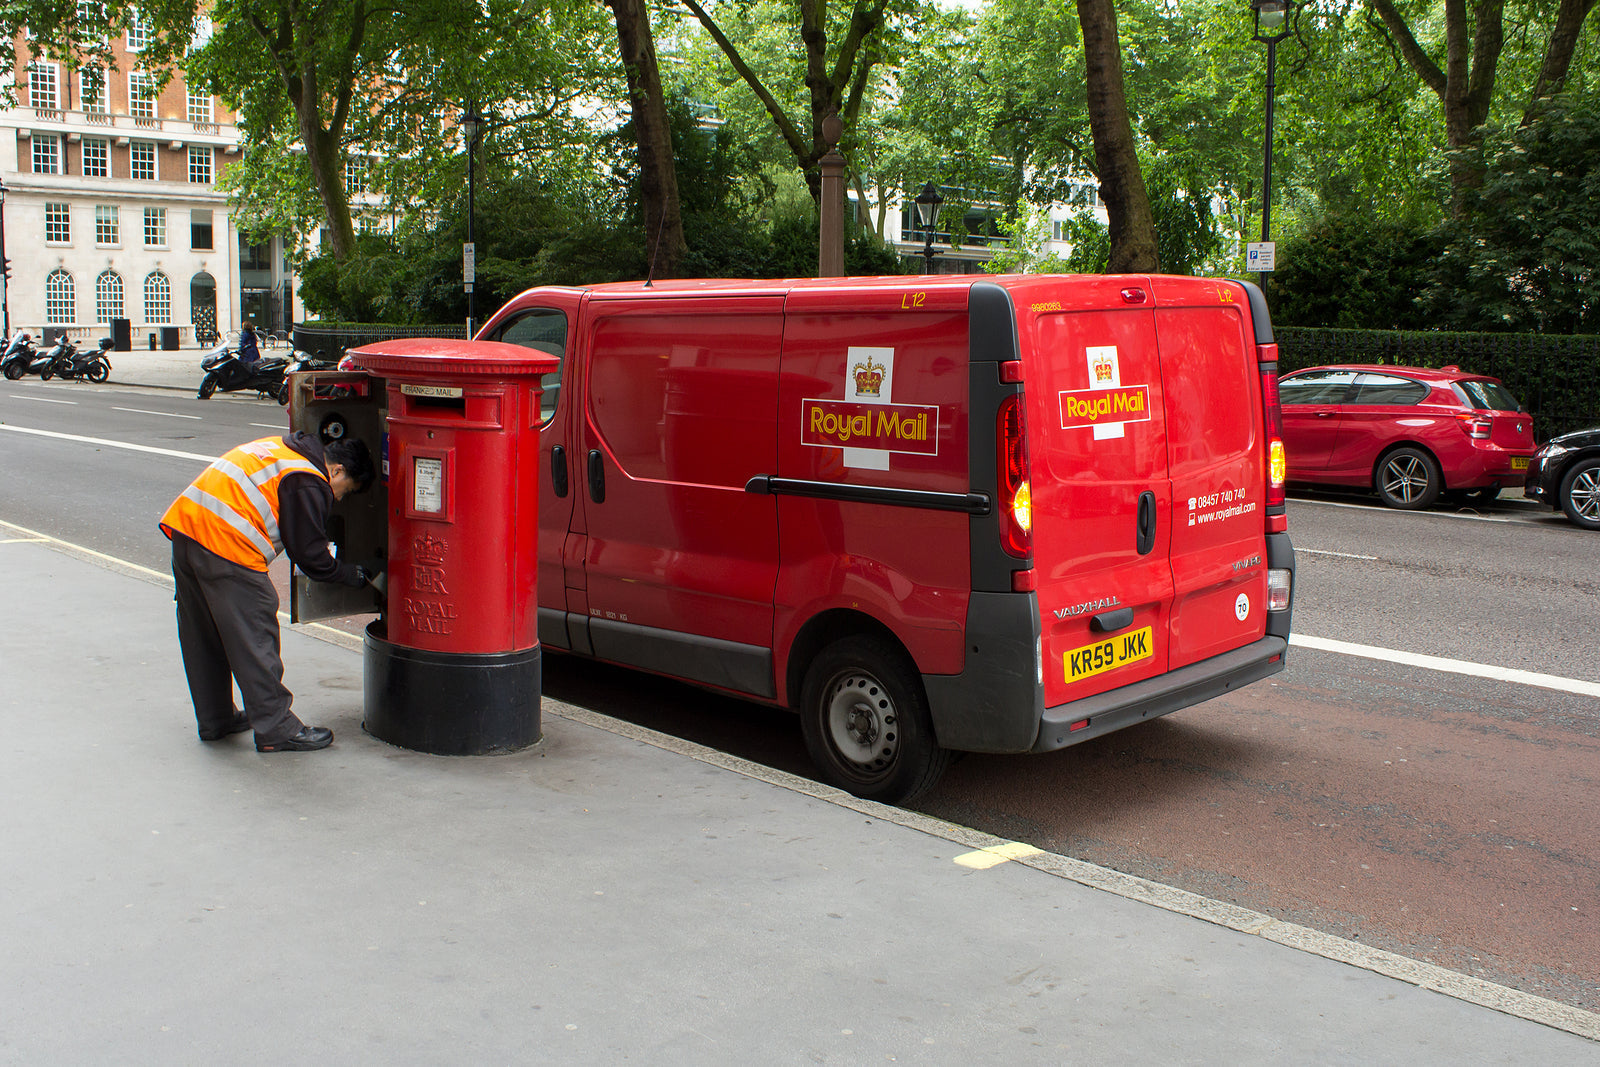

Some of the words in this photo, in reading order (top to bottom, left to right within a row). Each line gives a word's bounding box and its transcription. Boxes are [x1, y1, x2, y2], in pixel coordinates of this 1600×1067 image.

[404, 385, 434, 395] FRANKED
[435, 388, 454, 397] MAIL
[1066, 393, 1111, 421] Royal
[1113, 391, 1144, 413] Mail
[811, 406, 872, 441] Royal
[876, 410, 927, 441] Mail
[1198, 493, 1219, 509] 08457
[1221, 490, 1233, 504] 740
[1234, 487, 1246, 501] 740
[1197, 502, 1256, 524] www.royalmail.com
[1232, 556, 1261, 572] VIVARO
[404, 597, 457, 618] ROYAL
[1053, 596, 1121, 619] VAUXHALL
[1238, 602, 1247, 614] 70
[409, 615, 452, 635] MAIL
[1071, 642, 1114, 677] KR59
[1119, 631, 1147, 661] JKK
